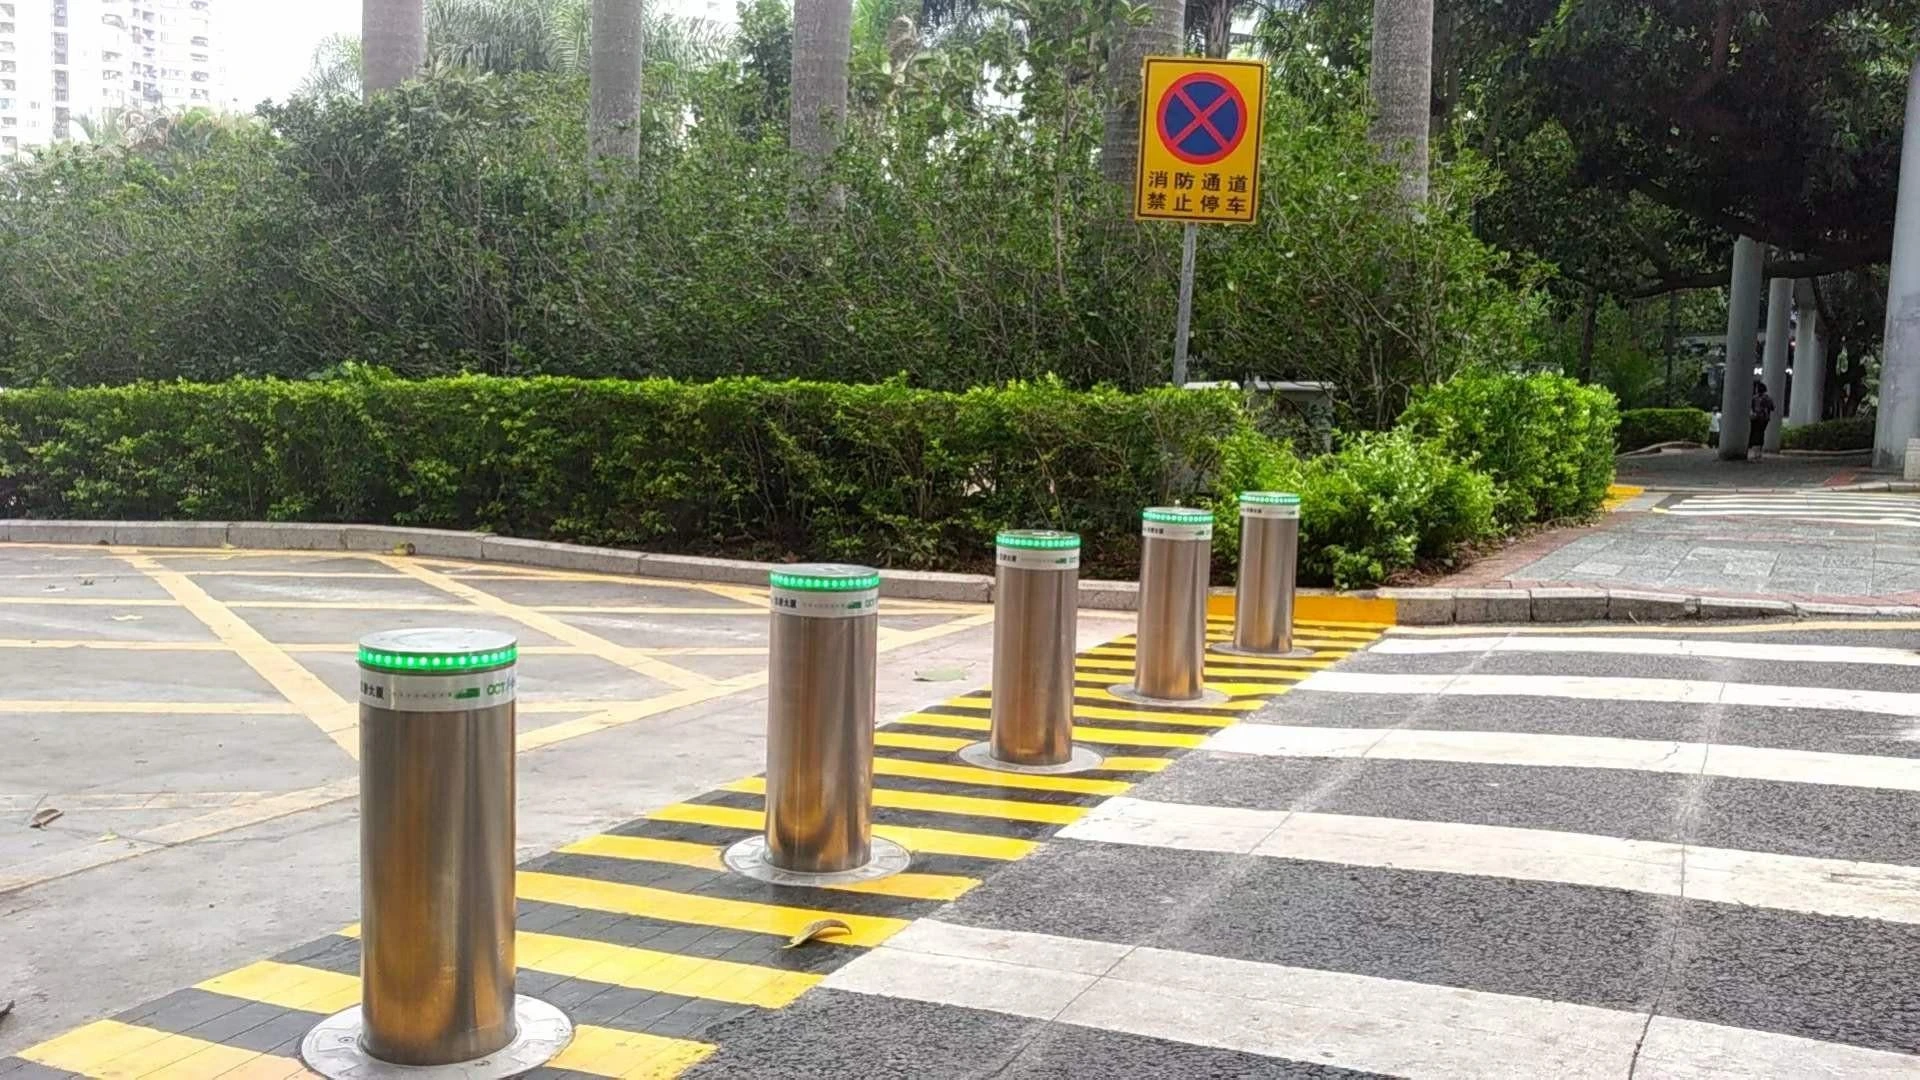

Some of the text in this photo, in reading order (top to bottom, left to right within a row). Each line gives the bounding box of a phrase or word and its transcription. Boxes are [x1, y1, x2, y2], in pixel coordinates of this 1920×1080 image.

[1148, 170, 1248, 193] 消防通道
[1147, 192, 1247, 215] 禁止停车
